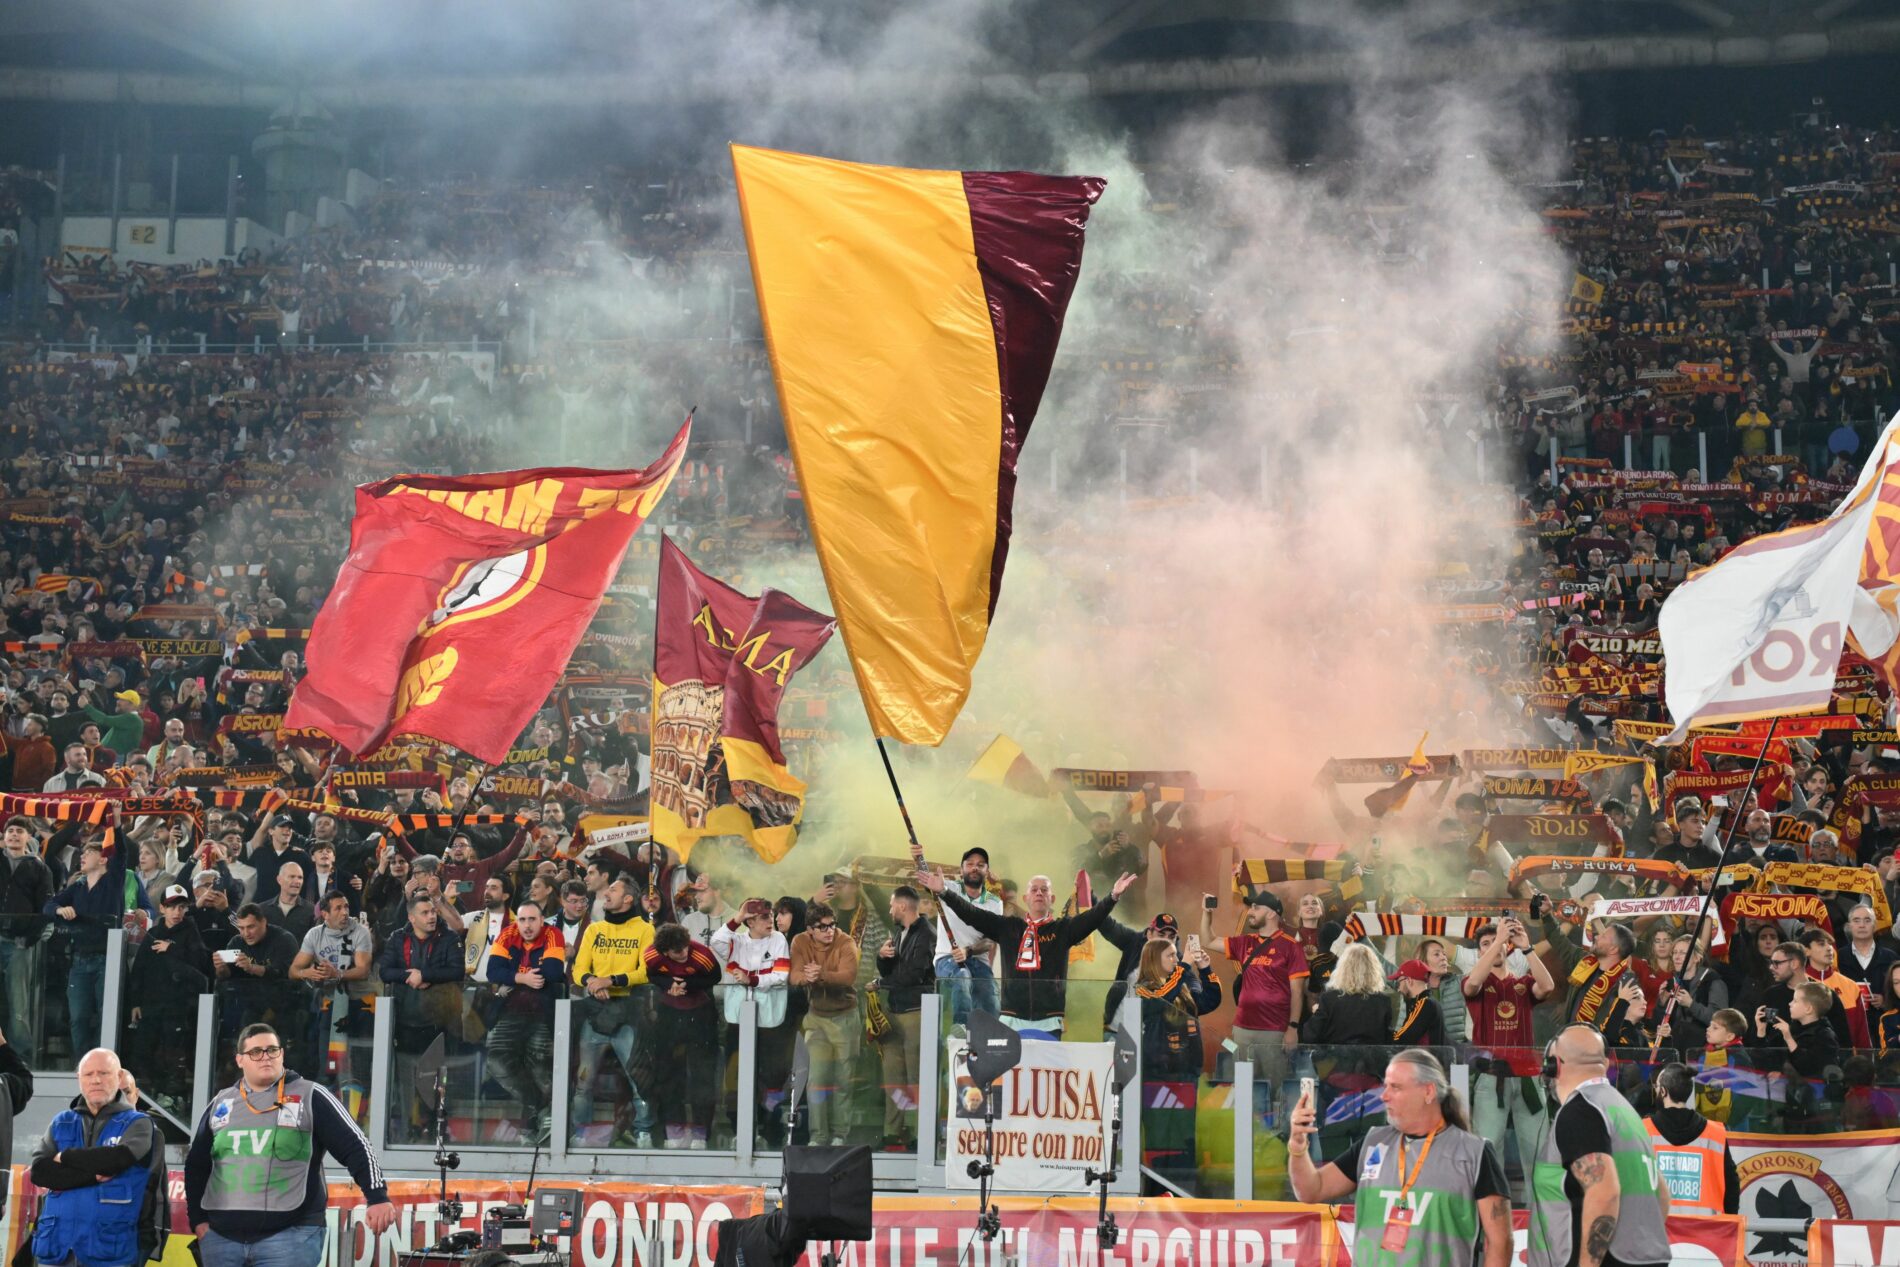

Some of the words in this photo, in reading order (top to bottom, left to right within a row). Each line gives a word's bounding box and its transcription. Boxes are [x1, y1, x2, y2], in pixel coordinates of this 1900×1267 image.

[144, 227, 155, 243] 2
[1763, 491, 1812, 503] ROMA
[1559, 580, 1600, 592] roma
[232, 670, 283, 681] ASROMA
[232, 714, 285, 732] ASROM
[1473, 750, 1527, 765] FORZA
[1529, 749, 1569, 764] ROM
[1070, 771, 1129, 788] ROMA
[1767, 767, 1775, 777] A
[479, 777, 539, 797] ASROMA
[1482, 775, 1546, 796] ROMA
[1871, 779, 1900, 790] CLU
[1551, 860, 1574, 871] AS
[1606, 896, 1701, 916] ASROMA
[1731, 895, 1829, 925] ASROMA
[599, 938, 640, 949] BOXEUR
[1010, 1067, 1102, 1121] LUISA
[227, 1129, 273, 1155] TV
[957, 1128, 1028, 1165] sempre
[1032, 1131, 1067, 1160] con
[1071, 1125, 1104, 1162] noi
[1659, 1155, 1700, 1173] STEWARD
[1379, 1190, 1434, 1226] TV
